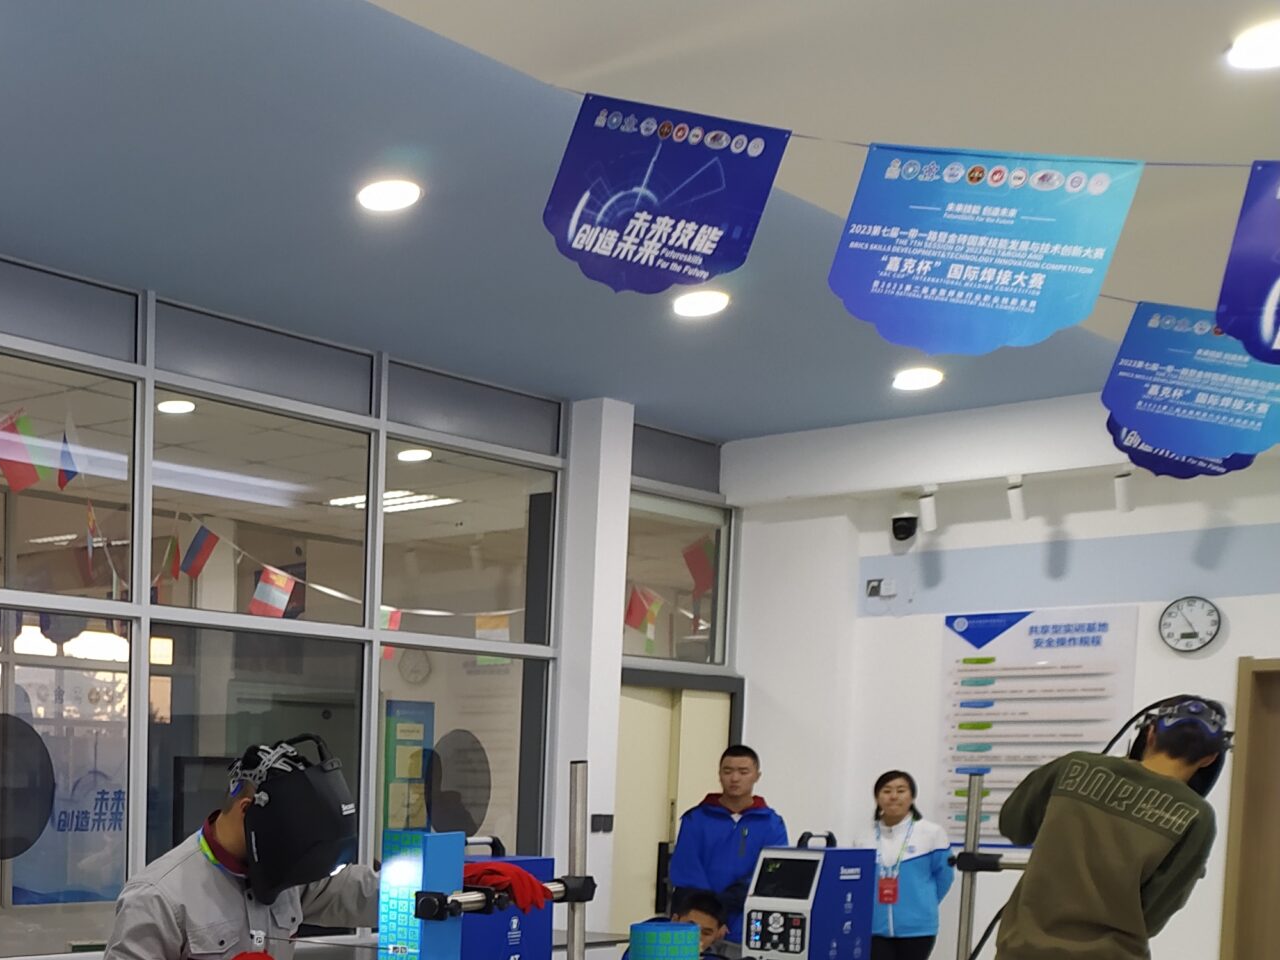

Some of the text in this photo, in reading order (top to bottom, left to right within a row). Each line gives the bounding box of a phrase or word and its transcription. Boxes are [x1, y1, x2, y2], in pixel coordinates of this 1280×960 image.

[571, 223, 659, 267] 创造未来
[623, 210, 724, 256] 未来技能
[659, 247, 704, 266] Futureskills
[849, 241, 869, 250] BRICS
[869, 243, 892, 252] SKILLS
[1041, 261, 1095, 275] COMPETITION
[656, 259, 710, 280] For the Future
[947, 263, 1047, 290] 国际焊接大赛
[1028, 622, 1109, 635] 共享型实训基地
[1033, 636, 1102, 649] 安全操作规程
[56, 809, 123, 833] 创造未来
